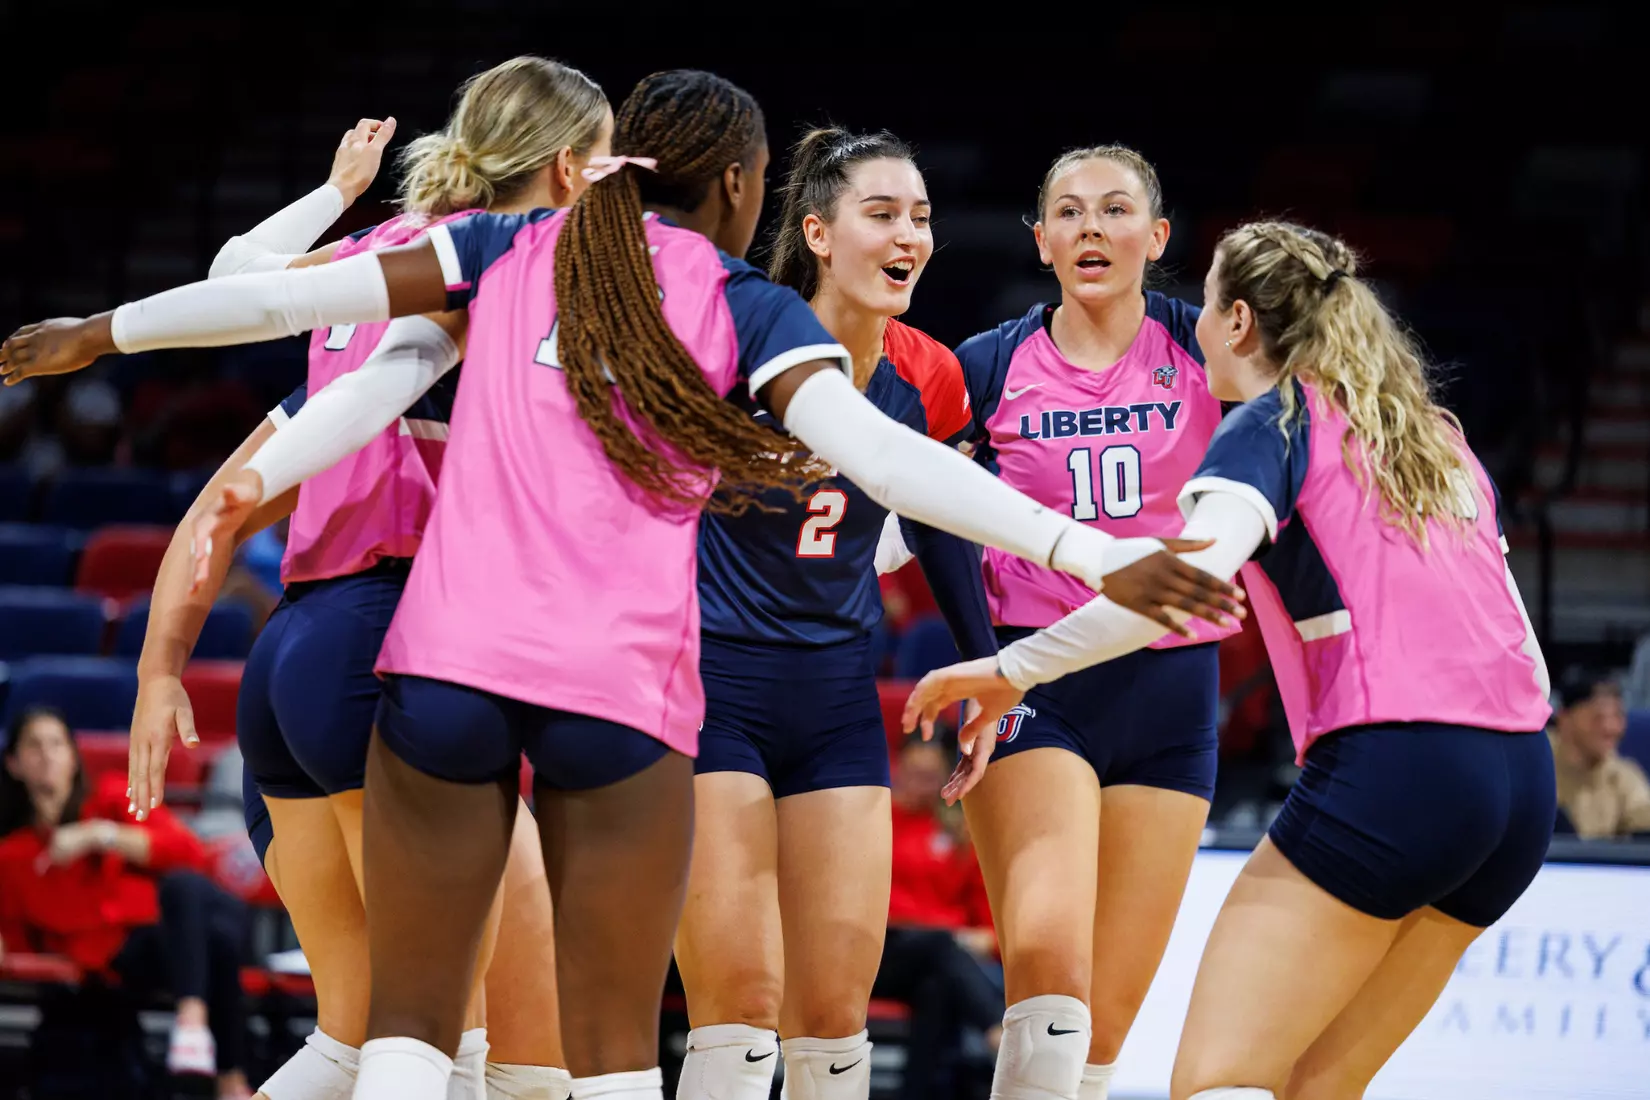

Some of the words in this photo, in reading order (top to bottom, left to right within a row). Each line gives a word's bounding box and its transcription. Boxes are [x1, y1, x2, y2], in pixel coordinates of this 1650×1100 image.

[1019, 400, 1182, 440] LIBERTY
[1067, 444, 1143, 521] 10
[796, 489, 848, 558] 2
